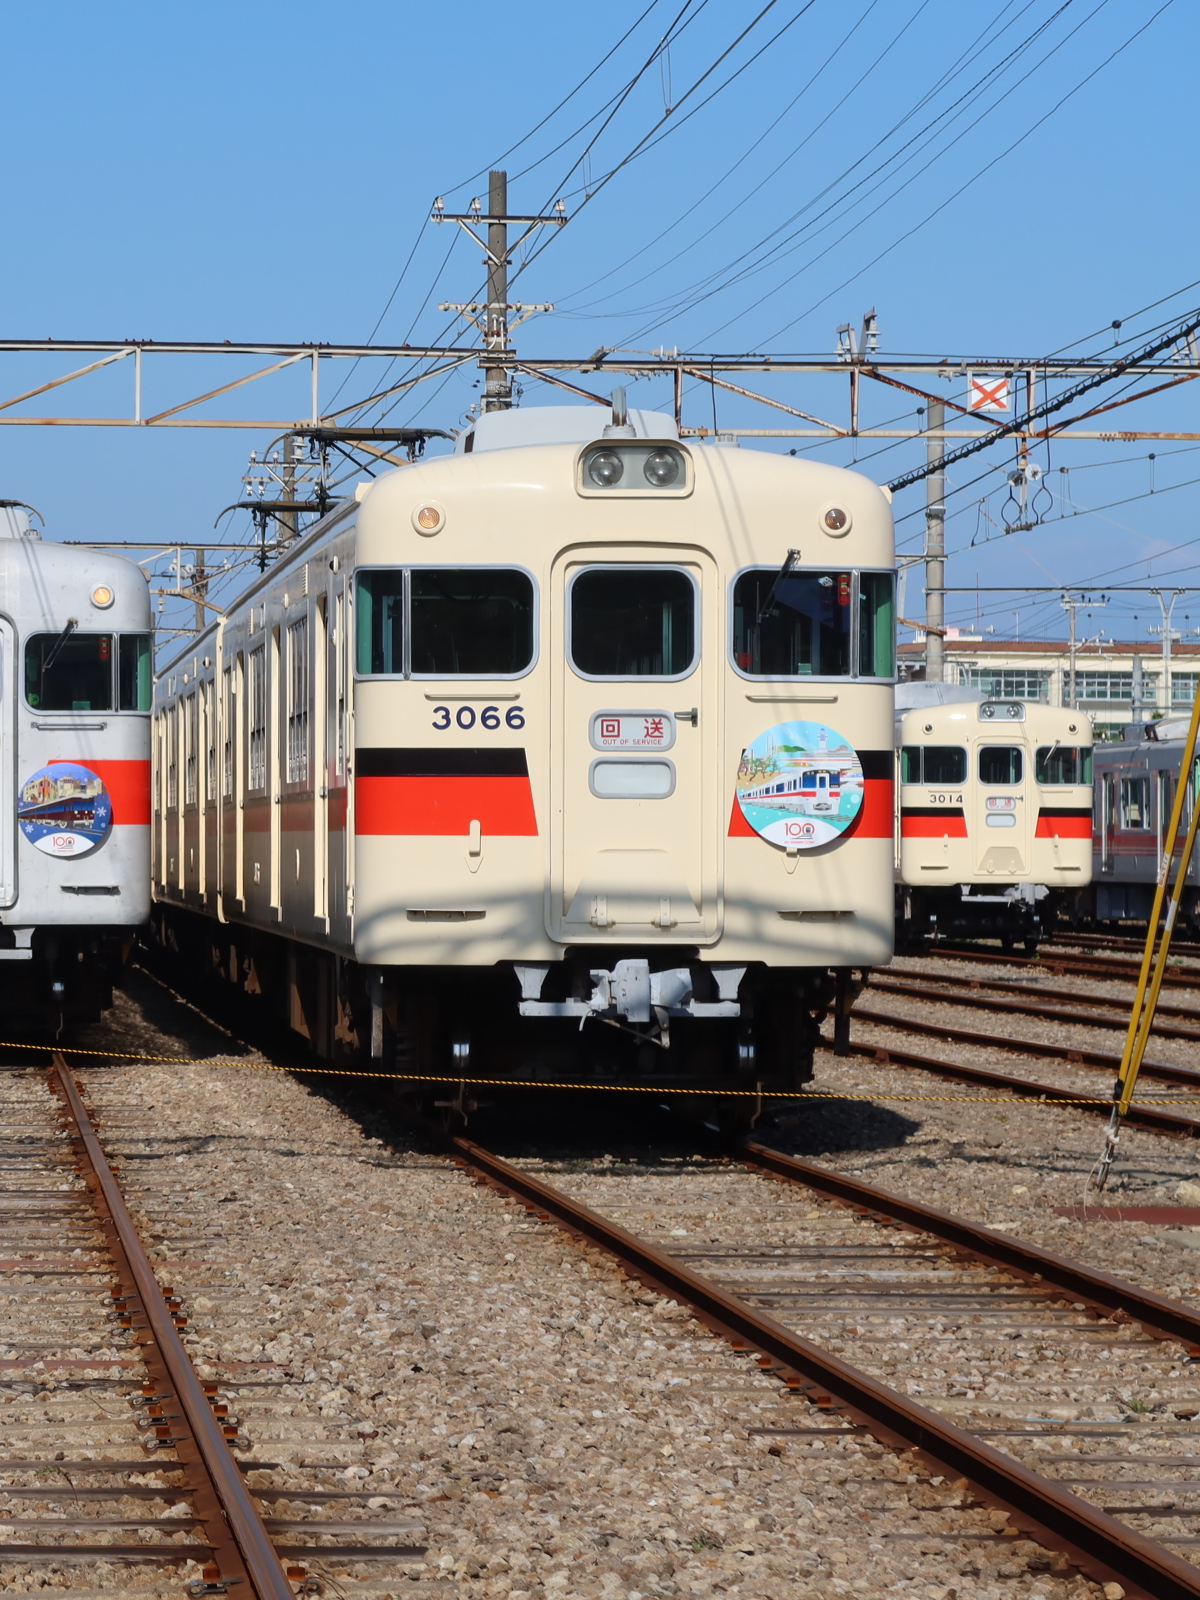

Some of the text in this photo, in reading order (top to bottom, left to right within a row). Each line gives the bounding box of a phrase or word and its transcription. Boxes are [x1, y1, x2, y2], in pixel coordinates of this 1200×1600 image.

[431, 705, 526, 730] 3066
[600, 718, 664, 738] 回送
[602, 738, 662, 746] OUT OF SERVICE
[929, 794, 963, 804] 3014
